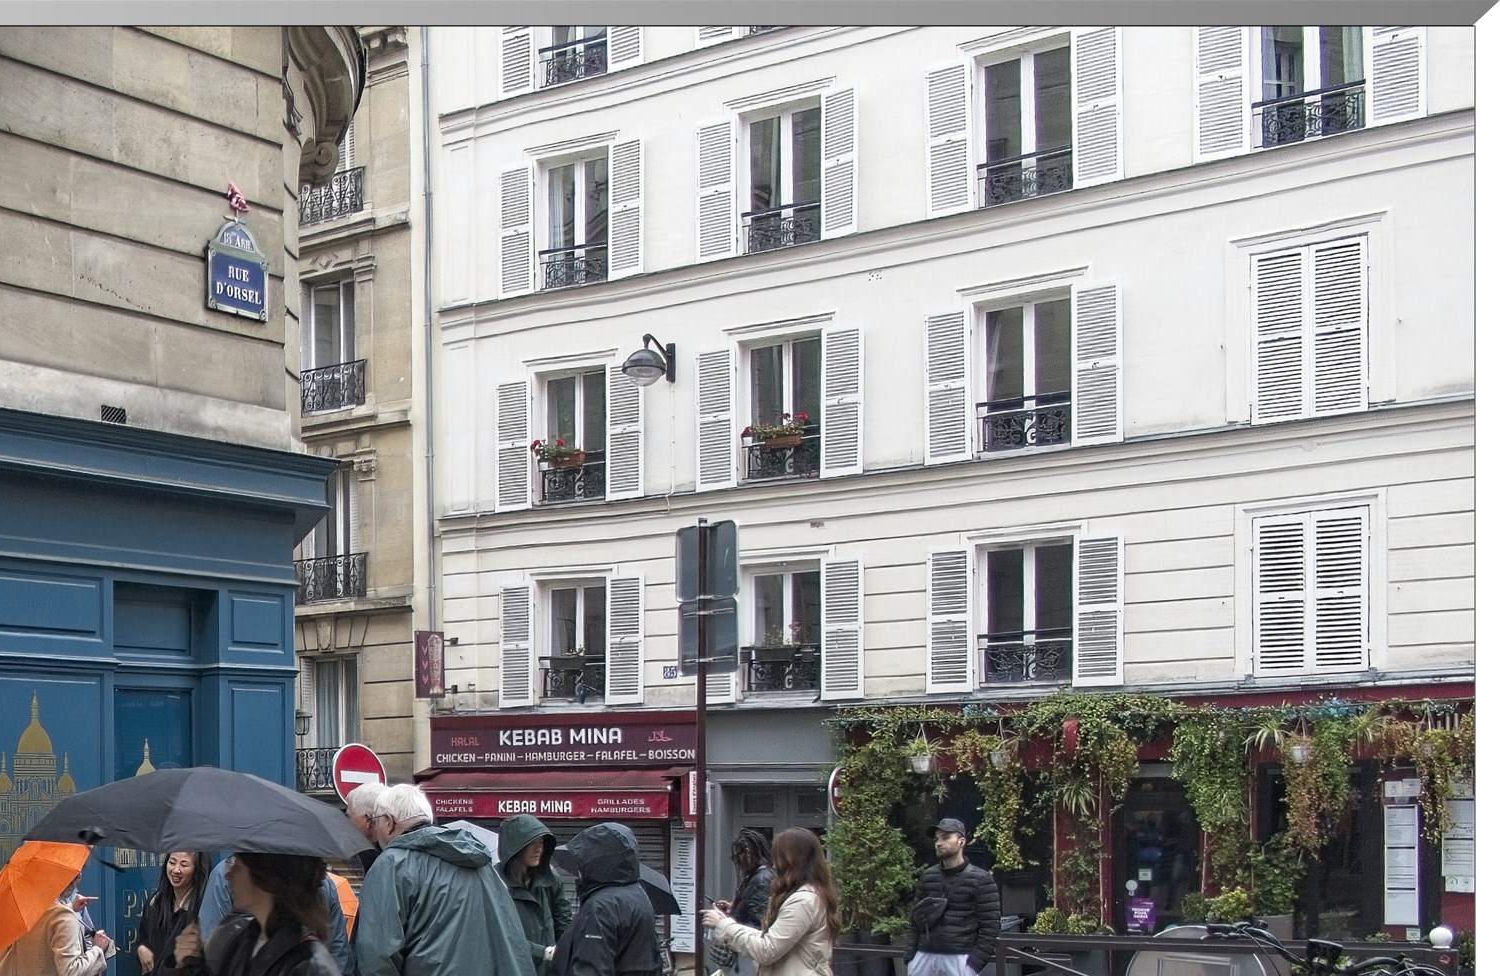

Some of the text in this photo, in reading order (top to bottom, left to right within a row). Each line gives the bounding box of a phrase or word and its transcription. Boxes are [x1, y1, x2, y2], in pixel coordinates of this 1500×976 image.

[228, 266, 249, 282] RUE
[216, 281, 262, 305] D'ORSEL
[451, 737, 479, 747] HALAL
[499, 727, 622, 746] KEBAB MINA
[436, 749, 695, 763] CHICKEN PANINI HAMBURGER FALAFEL BOISSON
[498, 800, 572, 813] KEBAB MINA
